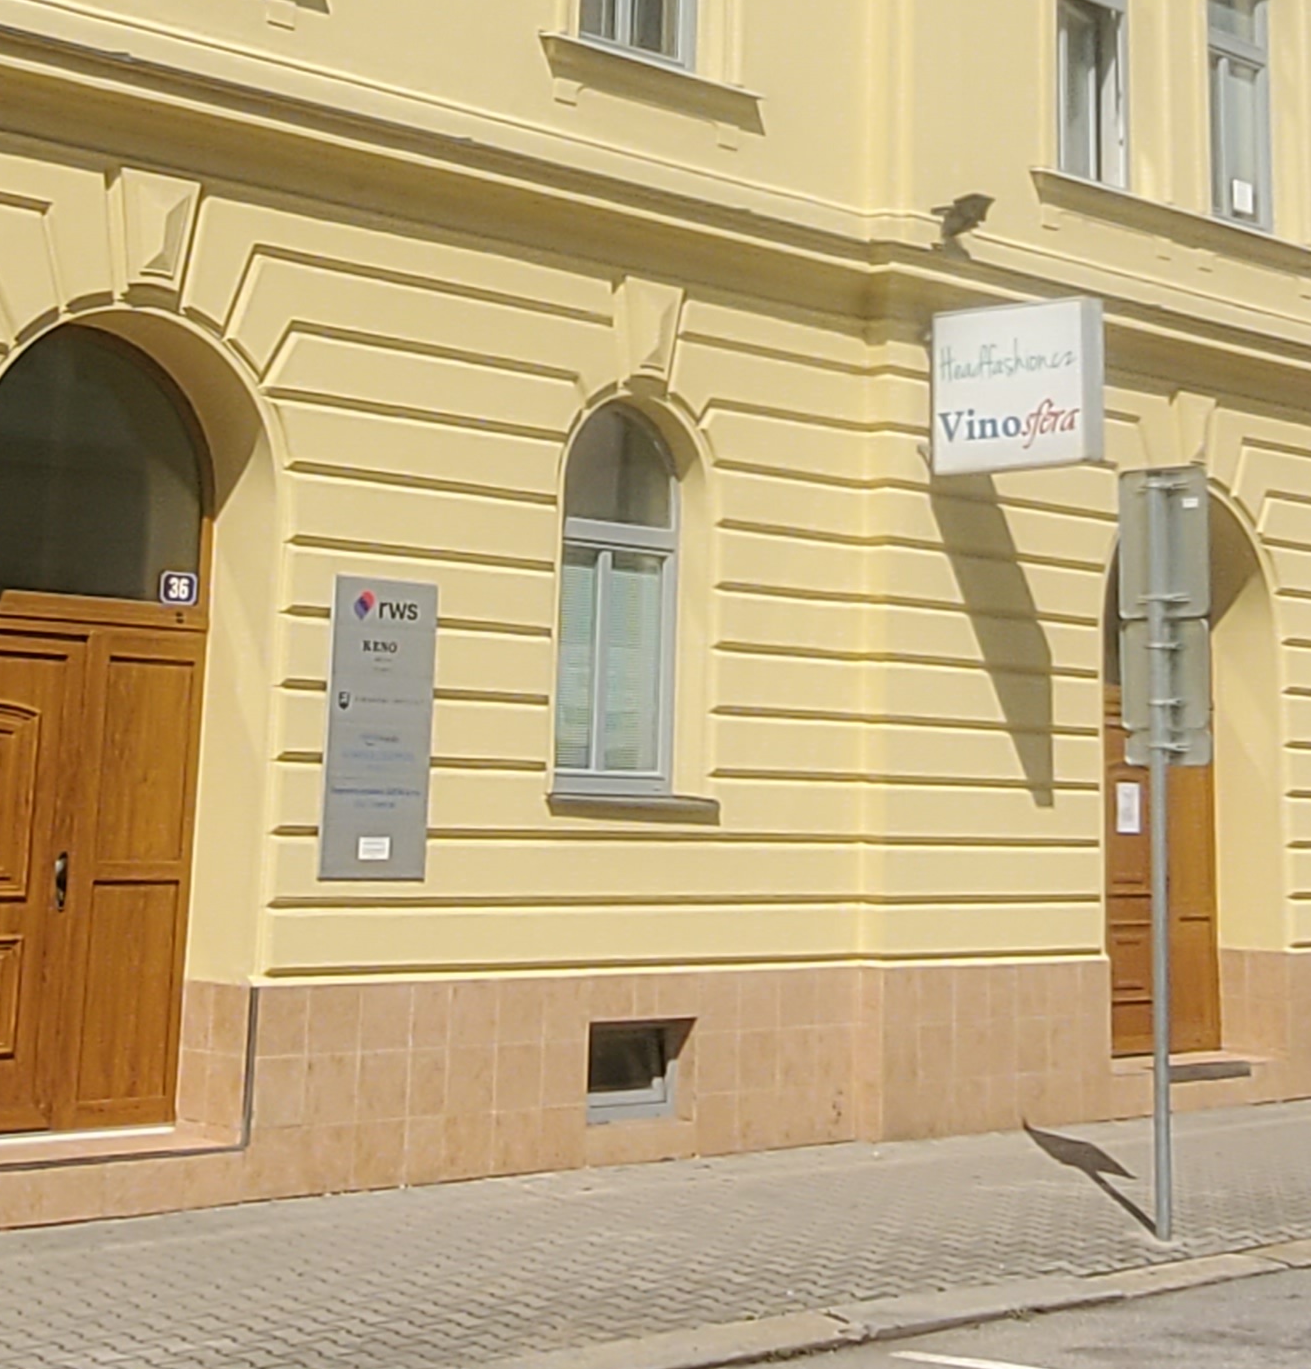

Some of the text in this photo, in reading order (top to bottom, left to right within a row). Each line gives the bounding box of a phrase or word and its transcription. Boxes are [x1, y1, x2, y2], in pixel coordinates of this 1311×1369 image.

[938, 398, 1080, 449] Vinosfera
[168, 576, 190, 600] 36
[378, 601, 419, 621] rws
